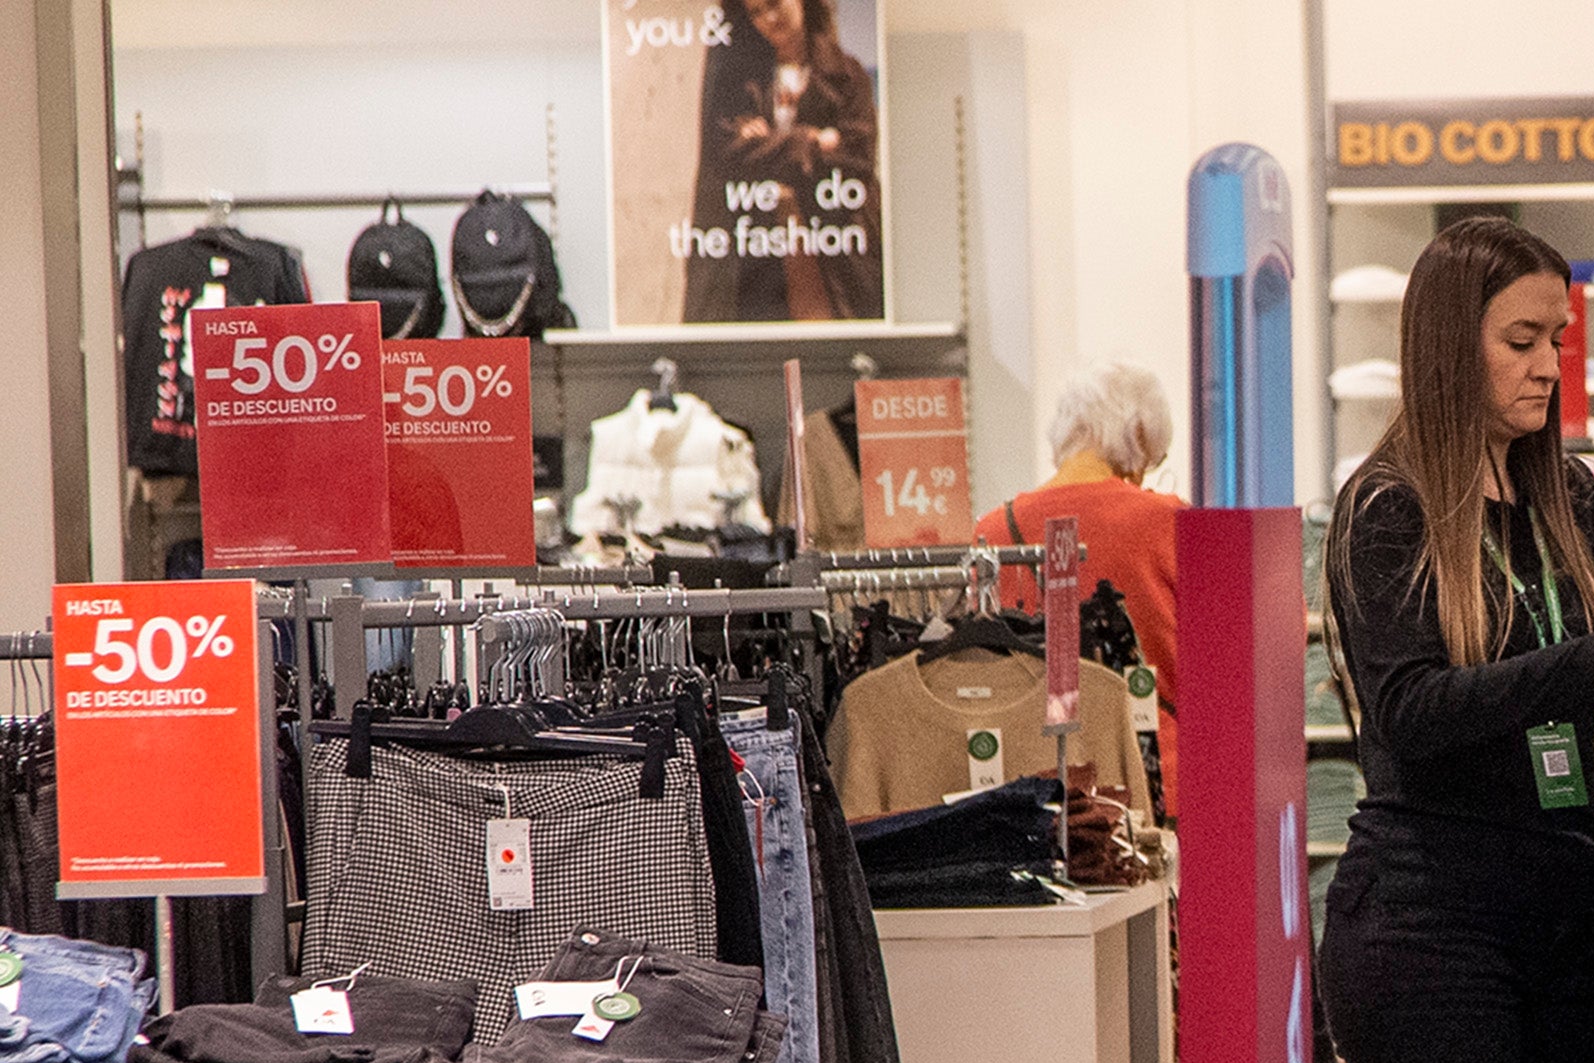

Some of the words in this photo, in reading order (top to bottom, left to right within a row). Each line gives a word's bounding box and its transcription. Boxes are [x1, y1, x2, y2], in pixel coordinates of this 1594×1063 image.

[625, 17, 693, 57] you
[700, 6, 734, 47] &
[1338, 120, 1435, 166] BIO
[725, 179, 781, 213] we
[815, 167, 868, 210] do
[668, 217, 731, 259] the
[735, 214, 868, 258] fashion
[205, 321, 258, 335] HASTA
[205, 333, 361, 395] -50%
[381, 352, 425, 364] HASTA
[207, 401, 231, 416] DE
[233, 397, 337, 415] DESCUENTO
[382, 364, 513, 417] -50%
[871, 394, 949, 421] DESDE
[403, 420, 492, 435] DESCUENTO
[66, 599, 124, 616] HASTA
[65, 614, 235, 684] -50%
[66, 691, 92, 708] DE
[94, 688, 207, 707] DESCUENTO
